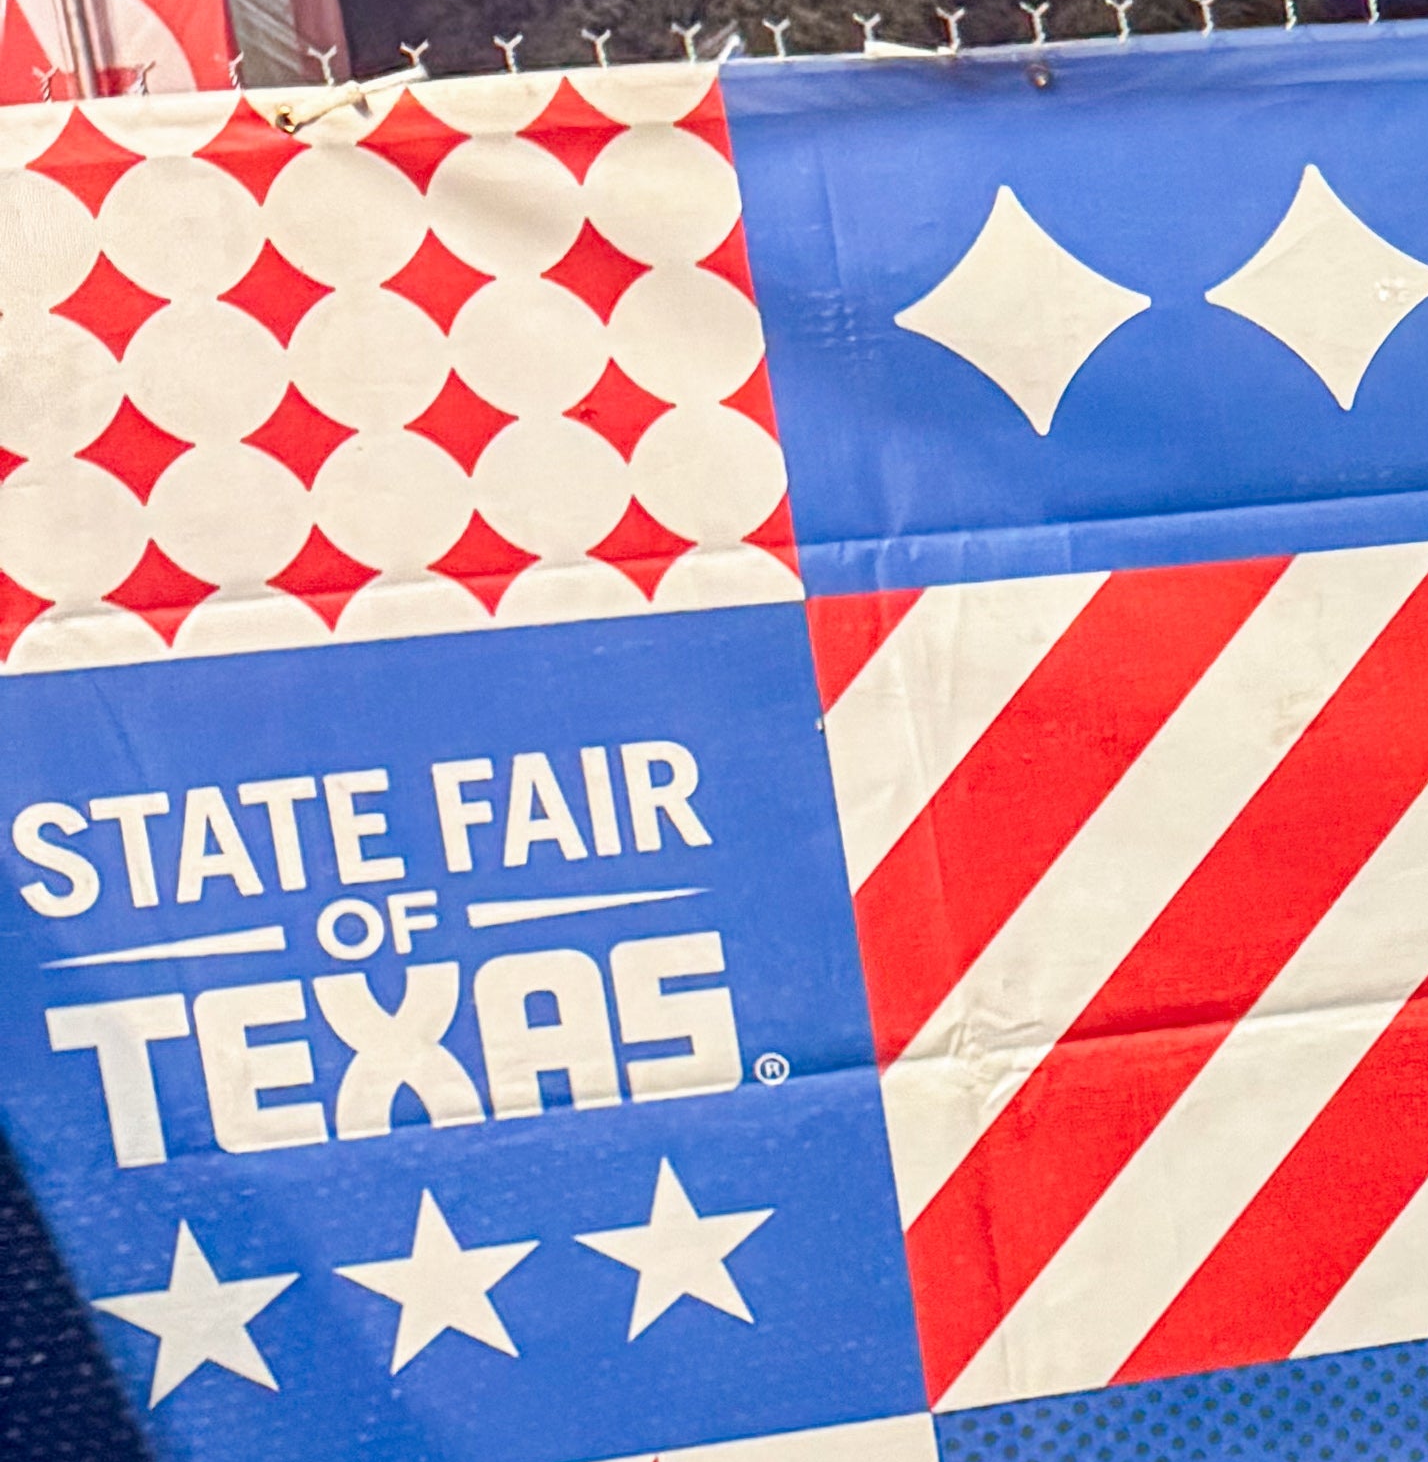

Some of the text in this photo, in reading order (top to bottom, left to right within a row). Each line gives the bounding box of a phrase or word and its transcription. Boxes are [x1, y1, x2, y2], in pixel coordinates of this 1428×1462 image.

[12, 740, 713, 918] STATE FAIR
[316, 890, 439, 961] OF
[44, 930, 742, 1169] TEXAS
